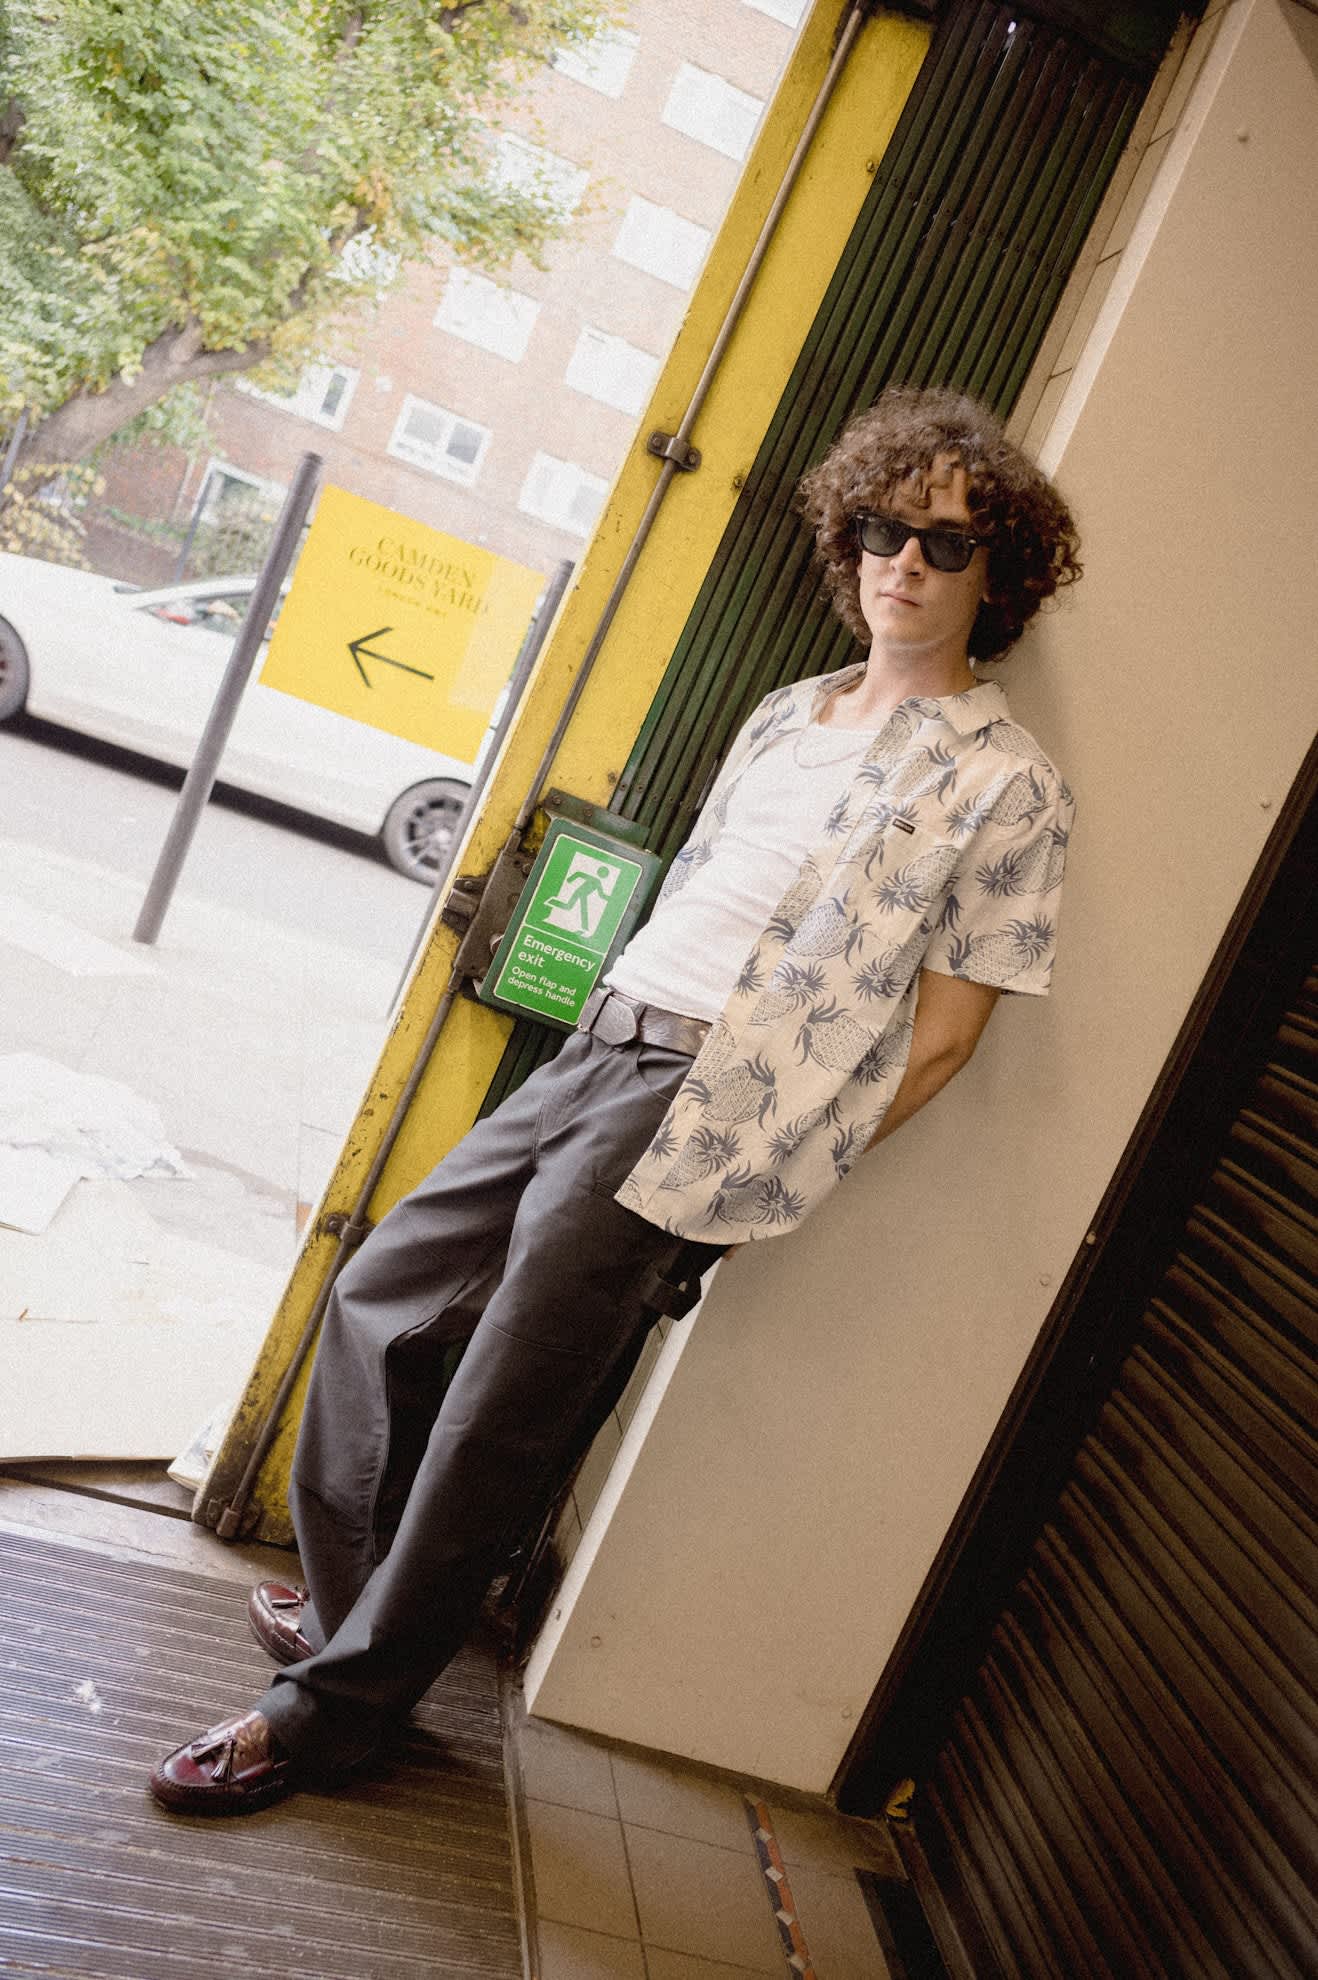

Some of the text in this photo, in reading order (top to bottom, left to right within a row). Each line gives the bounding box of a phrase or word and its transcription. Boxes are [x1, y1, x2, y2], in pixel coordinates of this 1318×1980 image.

[349, 546, 426, 588] GOODS
[378, 537, 475, 588] CAMDEN
[518, 951, 545, 969] exit
[523, 934, 596, 972] Emergency
[508, 976, 575, 1007] depress handle
[512, 966, 577, 996] Open flap and
